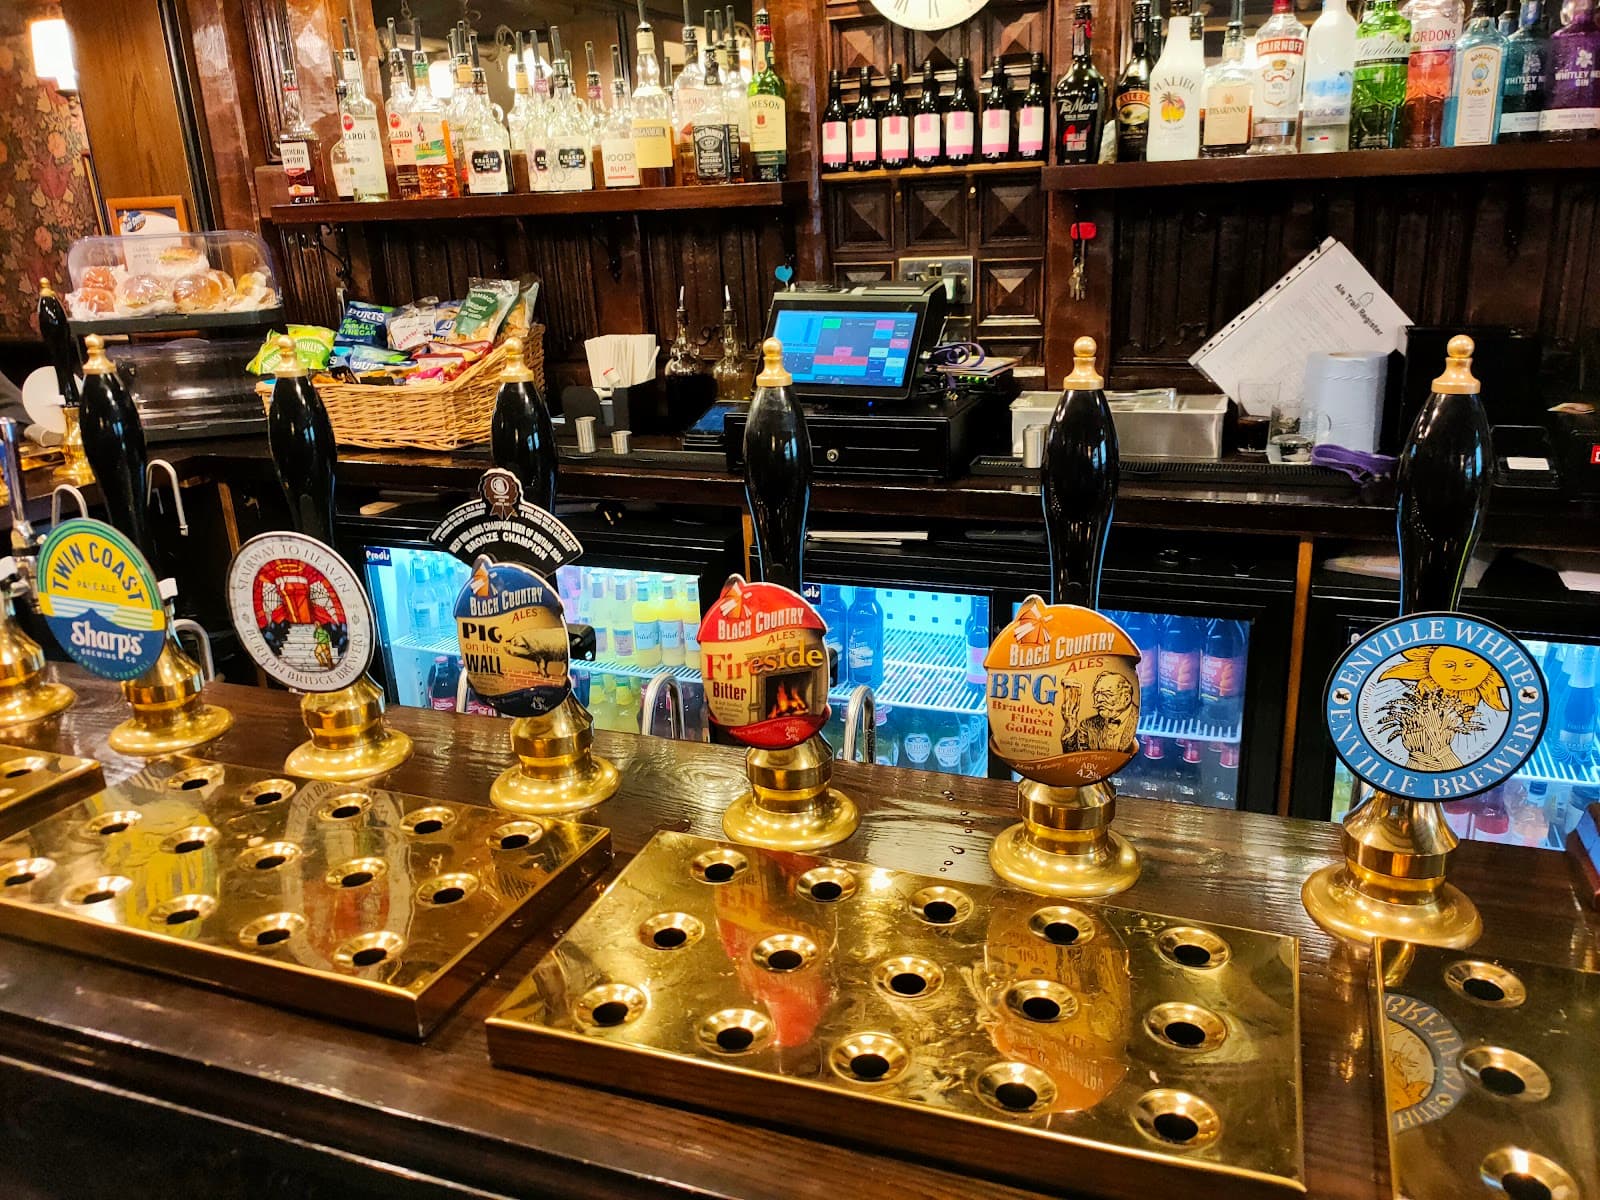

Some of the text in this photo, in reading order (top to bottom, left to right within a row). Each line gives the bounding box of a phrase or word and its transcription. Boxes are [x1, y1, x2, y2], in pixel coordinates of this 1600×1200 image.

[1257, 39, 1304, 55] SMIRNOFF
[1154, 76, 1196, 94] MALIBU
[751, 99, 781, 110] MESON
[1334, 283, 1384, 336] Ale Trail Register
[483, 521, 511, 532] CHAMPION
[512, 522, 526, 535] BEER
[526, 527, 534, 538] OF
[465, 531, 548, 560] BRONZE CHAMPION
[53, 542, 144, 602] TWIN COAST
[239, 544, 350, 594] STAIRWAY TO HEAVEN
[470, 587, 543, 616] BLACK COUNTRY
[511, 608, 538, 624] ALES
[718, 608, 804, 640] BLACK COUNTRY
[71, 620, 143, 661] Sharp's
[462, 622, 503, 644] PIG
[766, 631, 796, 646] ALES
[245, 629, 364, 686] BURTON BRIDGE BREWERY
[465, 643, 499, 654] on the
[1010, 632, 1115, 667] BLACK COUNTRY
[1338, 620, 1535, 688] ENVILLE WHITE
[465, 653, 504, 676] WALL
[705, 640, 823, 681] Fireside
[1065, 658, 1104, 676] ALES
[713, 682, 747, 701] Bitter
[990, 672, 1058, 706] BFG
[991, 700, 1055, 717] Bradley's
[1005, 723, 1053, 737] Golden
[1011, 713, 1054, 728] Finest
[1330, 707, 1541, 797] ENVILLE BREWERY
[1081, 762, 1098, 770] ABV
